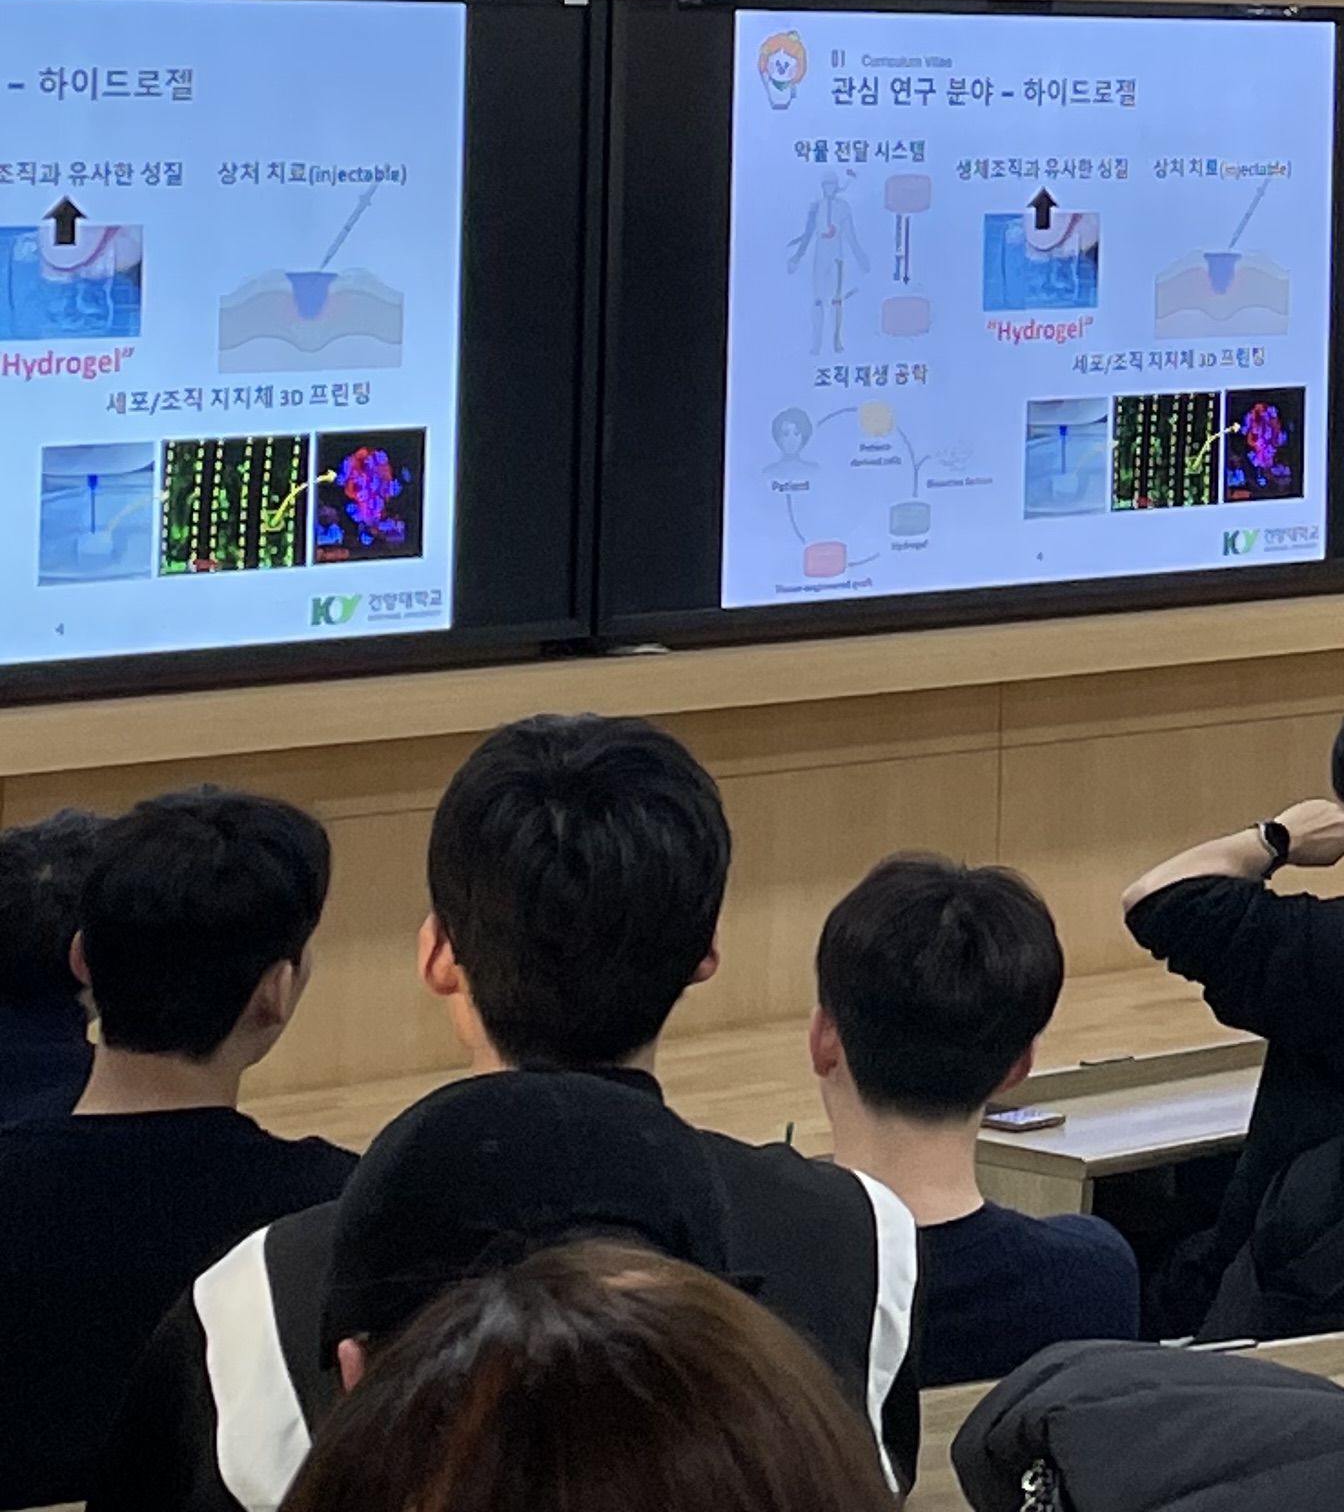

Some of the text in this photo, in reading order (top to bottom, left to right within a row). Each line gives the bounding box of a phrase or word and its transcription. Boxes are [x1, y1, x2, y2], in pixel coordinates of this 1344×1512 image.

[38, 66, 193, 101] 하이드로젤
[831, 76, 879, 106] 관심
[890, 76, 937, 106] 연구
[946, 76, 995, 106] 분야
[1023, 77, 1137, 107] 하이드로젤
[794, 140, 926, 163] 약물 전달 시스템
[67, 160, 134, 187] 유사한
[140, 161, 183, 187] 성질
[218, 161, 260, 185] 상처
[1045, 158, 1094, 180] 유사한
[1099, 158, 1128, 180] 성질
[814, 363, 928, 388] 조직 재생 공학
[106, 381, 371, 415] 세포/조직 지지체 3D 프린팅
